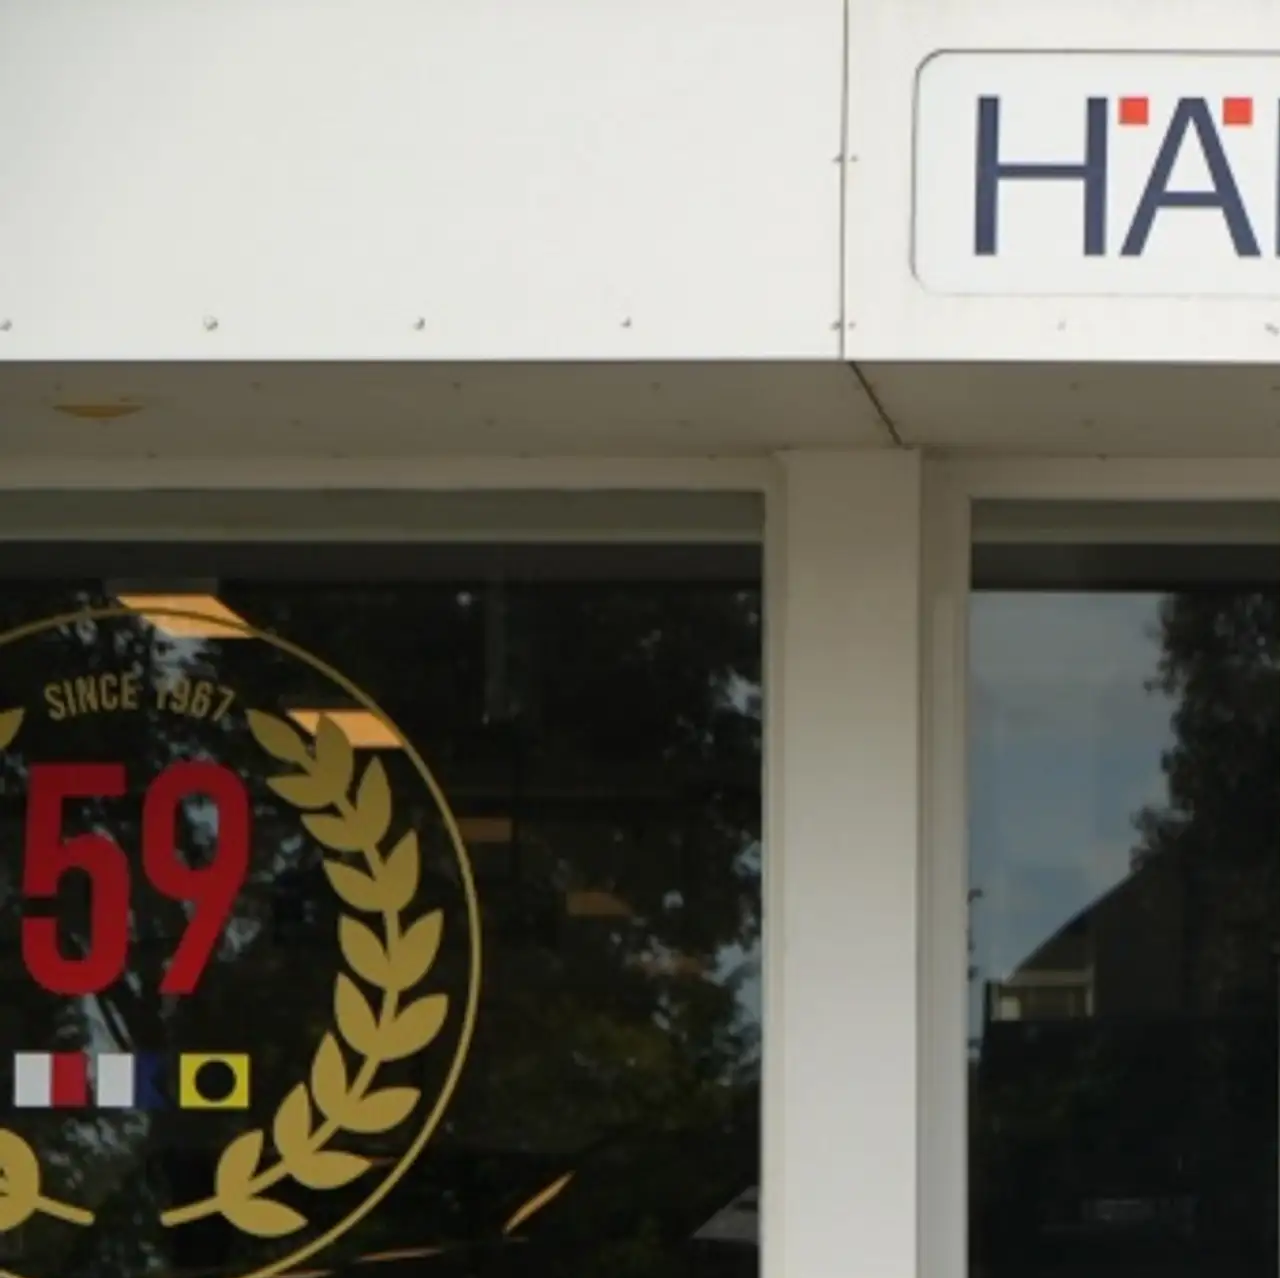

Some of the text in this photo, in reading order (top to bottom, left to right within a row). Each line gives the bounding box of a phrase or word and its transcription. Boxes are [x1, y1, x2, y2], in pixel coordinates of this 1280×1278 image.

[43, 670, 236, 721] SINCE 1967
[20, 760, 252, 997] 59
